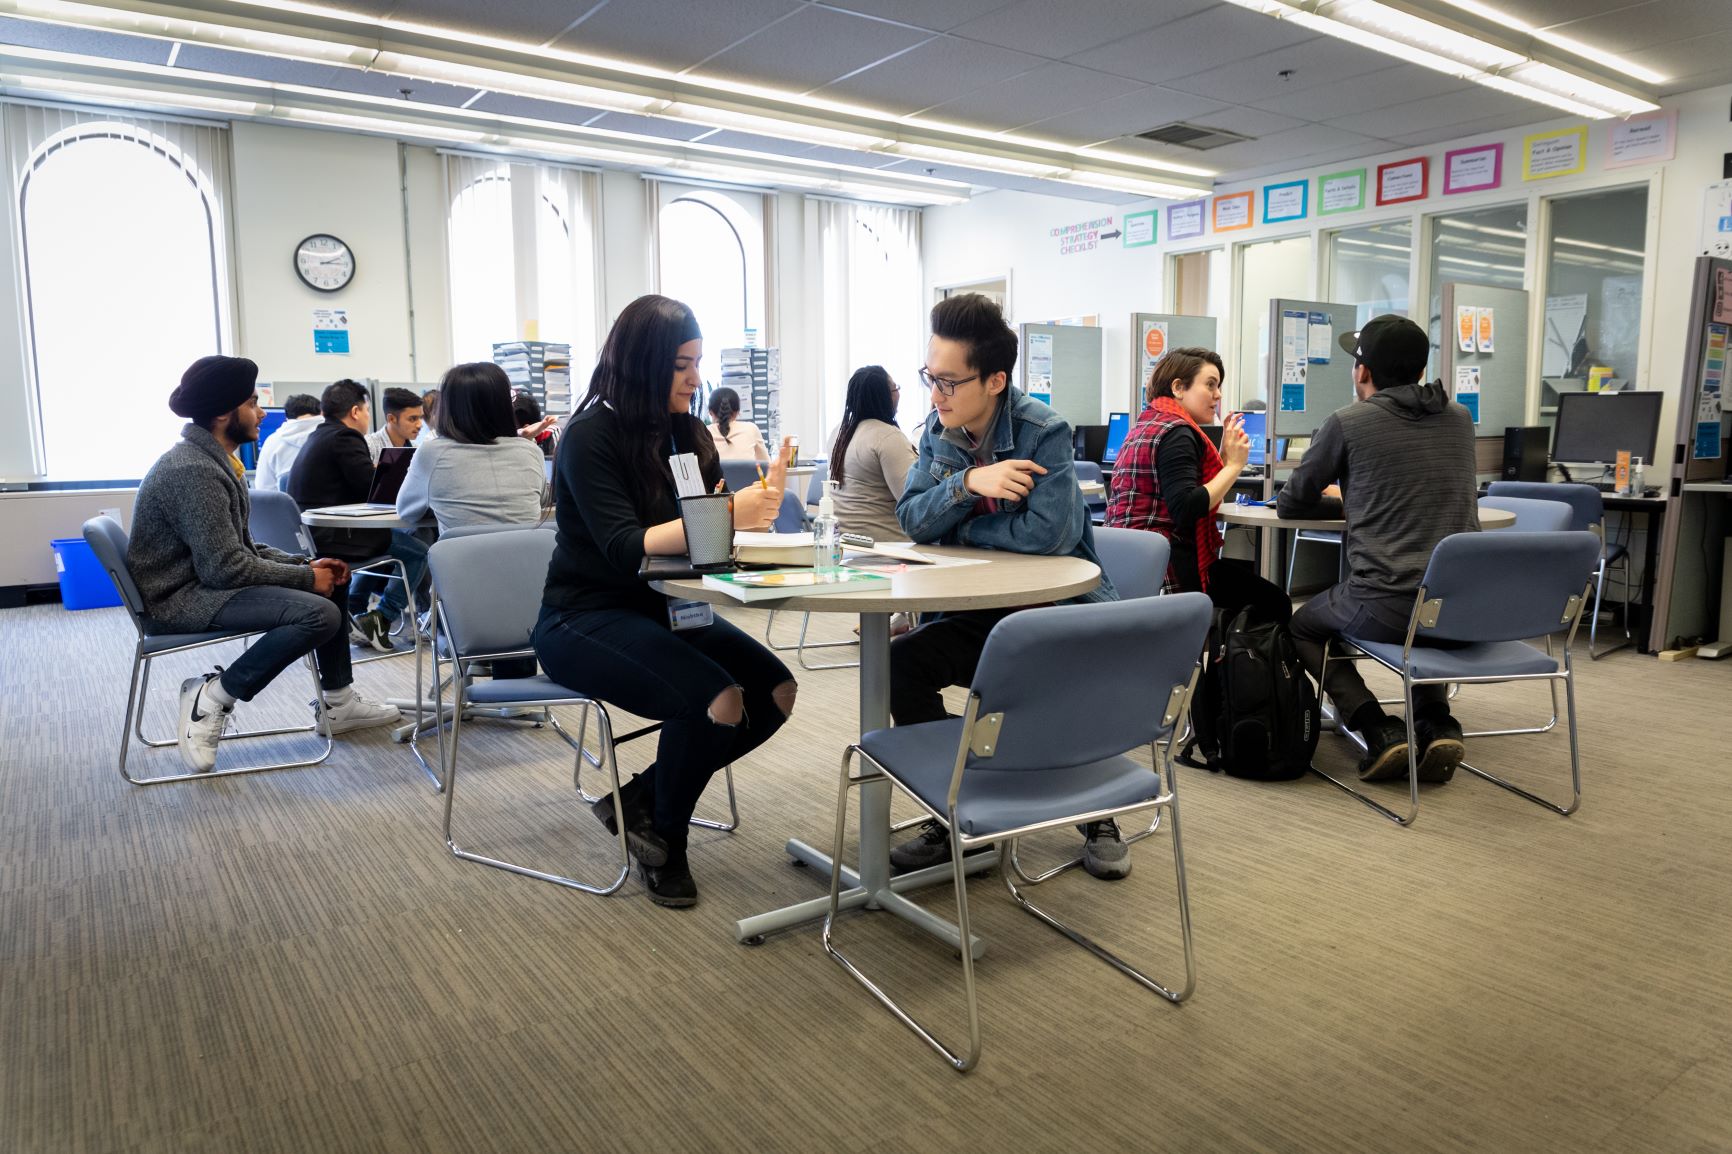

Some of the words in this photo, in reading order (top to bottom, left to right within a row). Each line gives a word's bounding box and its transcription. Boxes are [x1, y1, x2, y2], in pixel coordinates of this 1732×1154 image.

[1050, 217, 1113, 237] COMPREHENSION
[1060, 230, 1099, 246] STRATEGY
[1060, 241, 1098, 255] CHECKLIST
